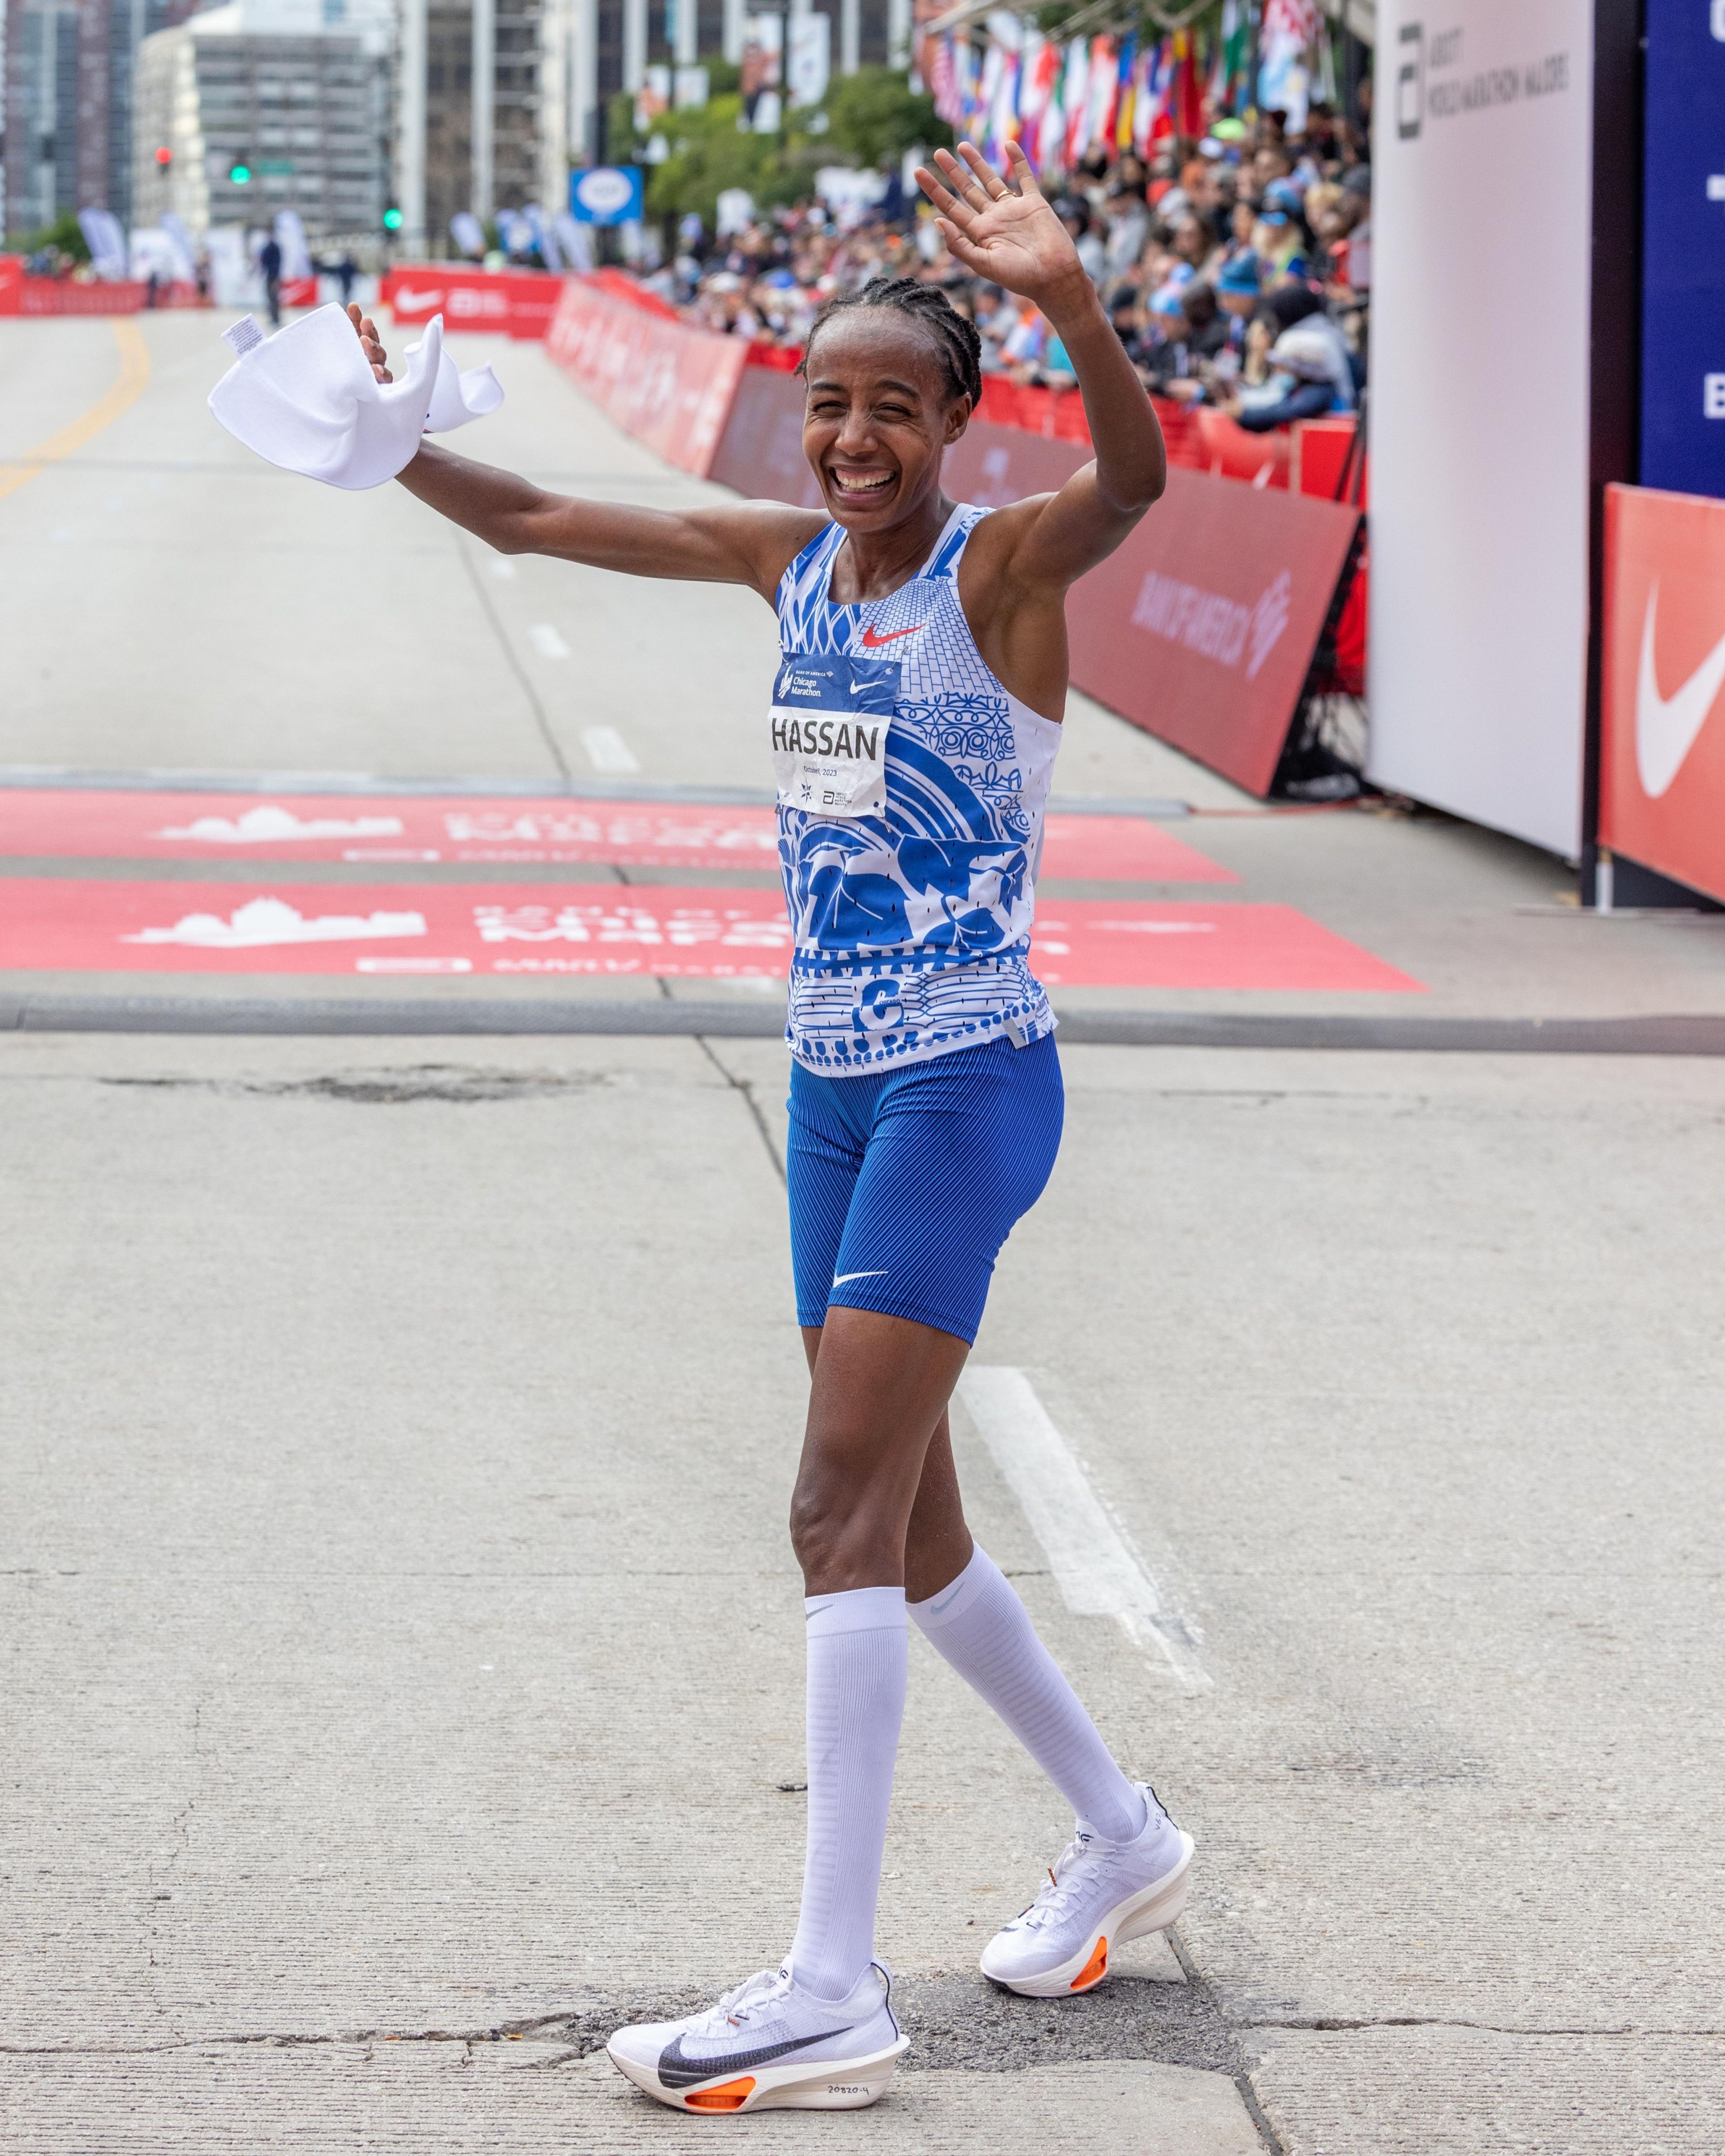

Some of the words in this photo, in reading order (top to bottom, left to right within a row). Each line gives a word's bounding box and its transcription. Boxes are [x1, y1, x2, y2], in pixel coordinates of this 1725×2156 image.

[793, 677, 817, 688] Chicago
[772, 718, 879, 760] HASSAN
[823, 769, 837, 777] 2023
[828, 2085, 869, 2095] 20820-4
